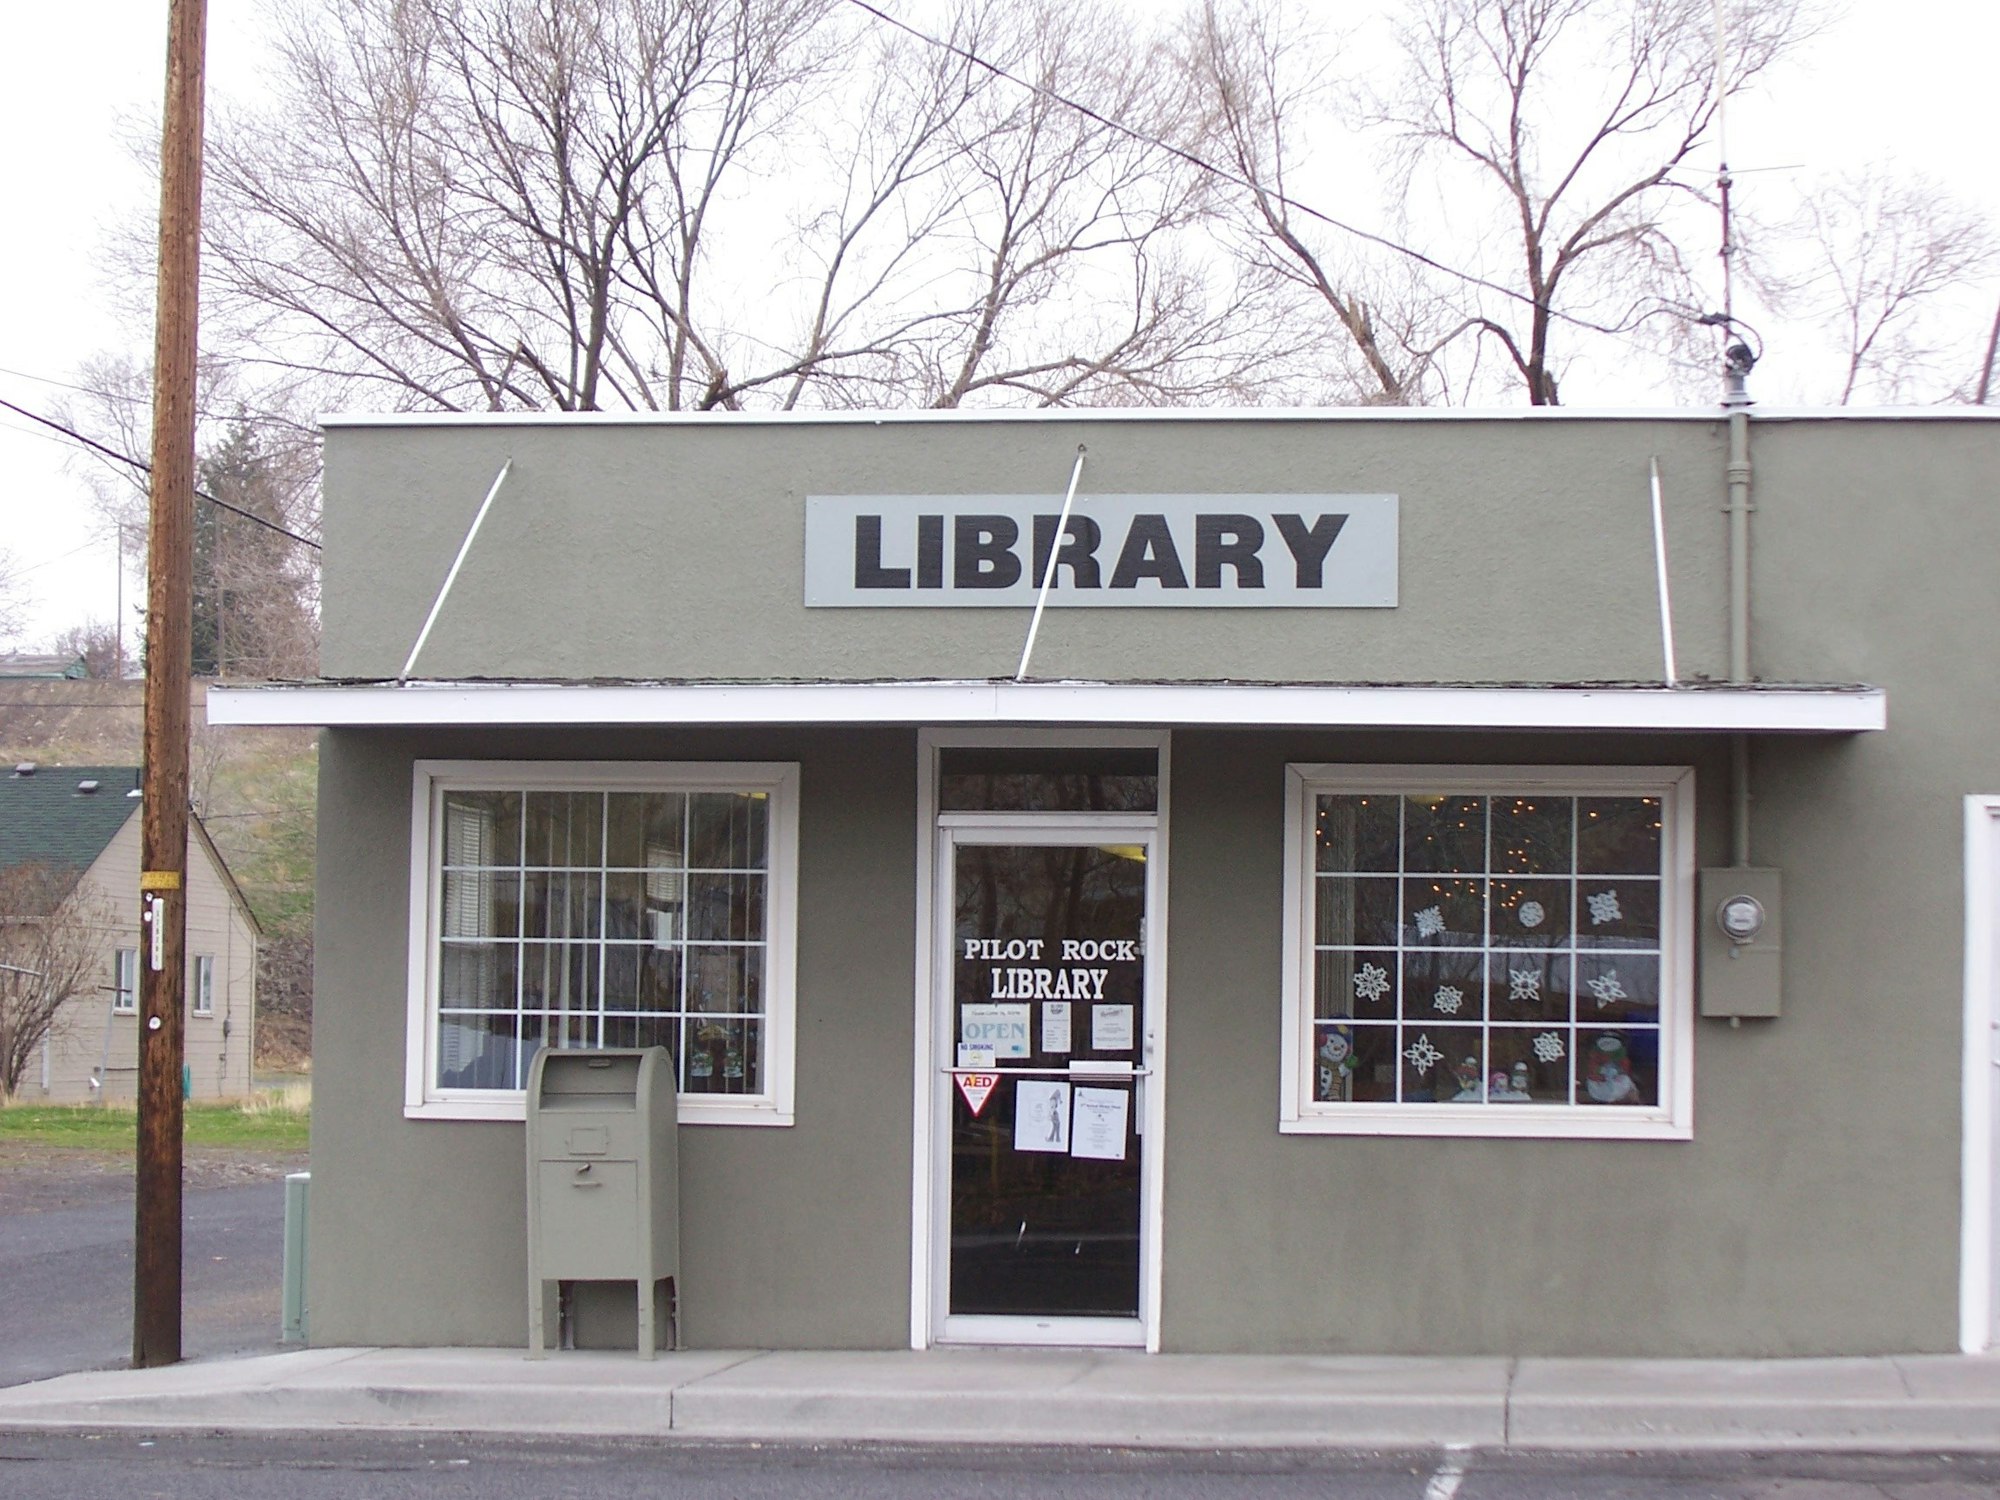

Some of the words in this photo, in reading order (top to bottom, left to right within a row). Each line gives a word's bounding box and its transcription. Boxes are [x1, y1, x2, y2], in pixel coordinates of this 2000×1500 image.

[854, 513, 1350, 589] LIBRARY
[964, 939, 1044, 960] PILOT
[1062, 940, 1136, 961] ROCK
[991, 968, 1108, 999] LIBRARY
[965, 1023, 1025, 1039] OPEN
[963, 1076, 992, 1087] AED
